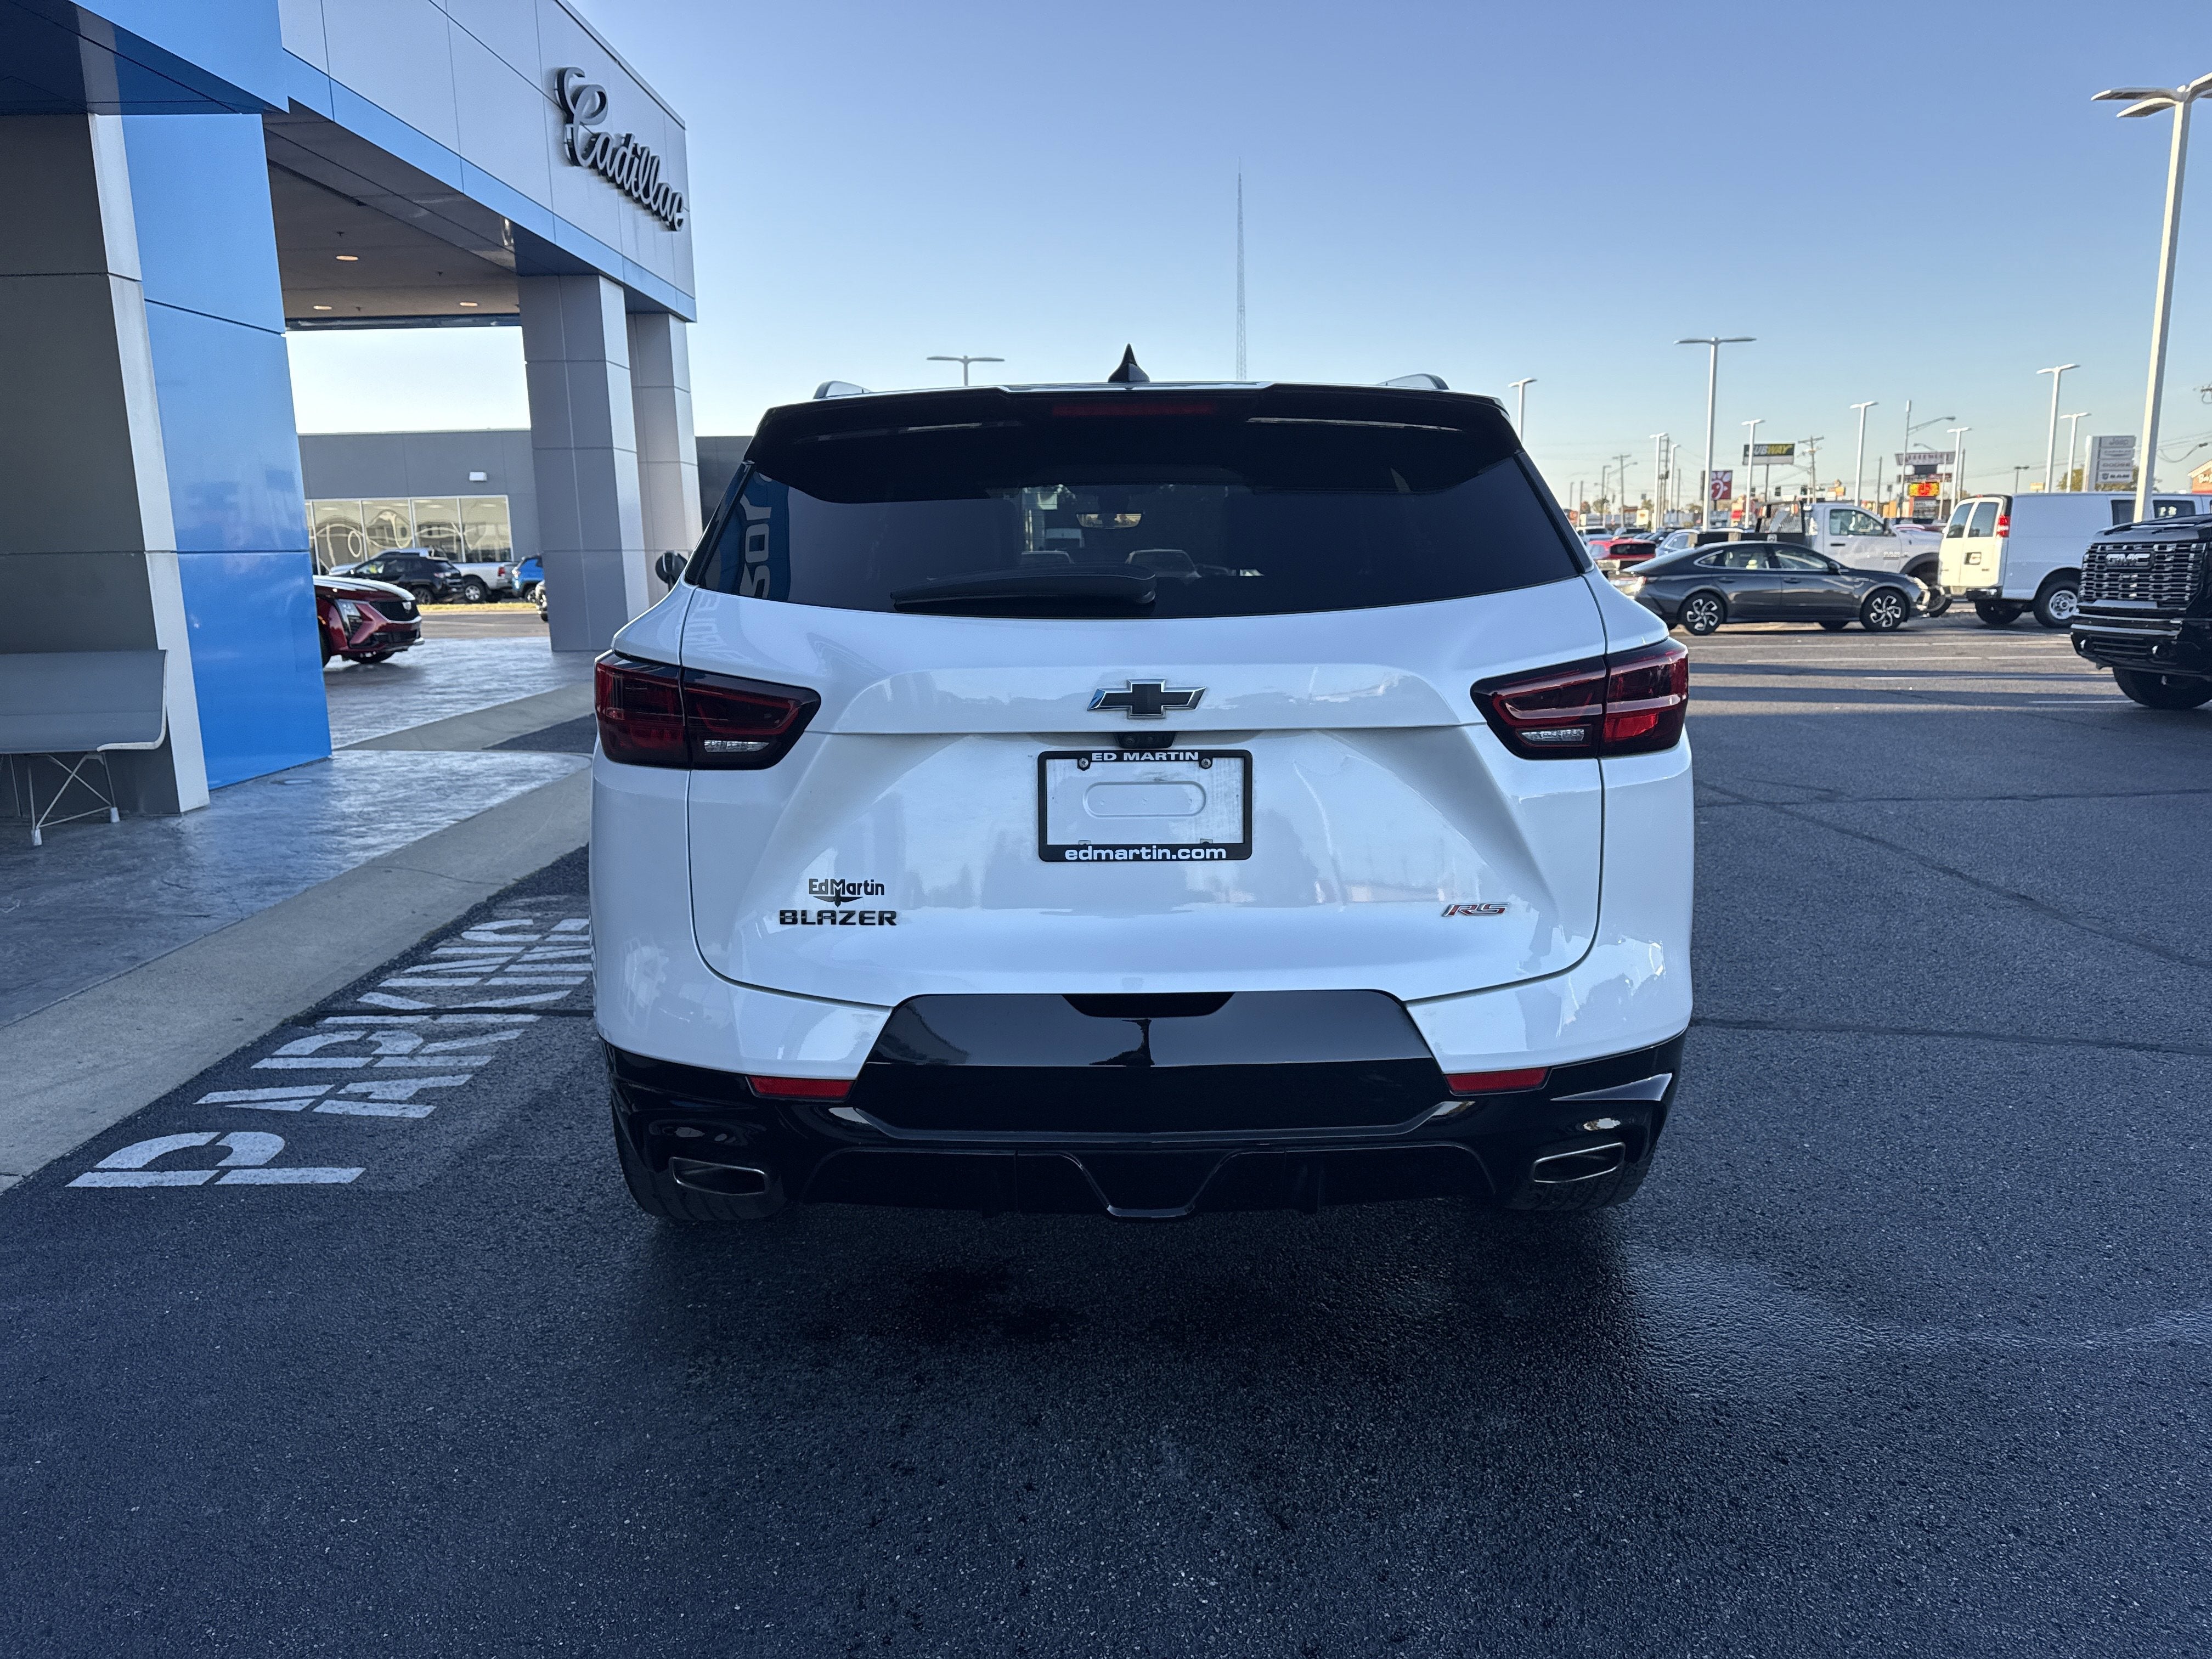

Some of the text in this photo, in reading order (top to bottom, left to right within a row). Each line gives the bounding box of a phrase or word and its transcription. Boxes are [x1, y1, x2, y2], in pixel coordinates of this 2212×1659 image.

[555, 66, 685, 231] Cadillac
[1092, 752, 1199, 761] ED MARTIN
[1065, 845, 1226, 860] edmartin.com
[1441, 902, 1511, 917] RS
[780, 910, 897, 926] BLAZER
[65, 918, 592, 1188] PARKING
